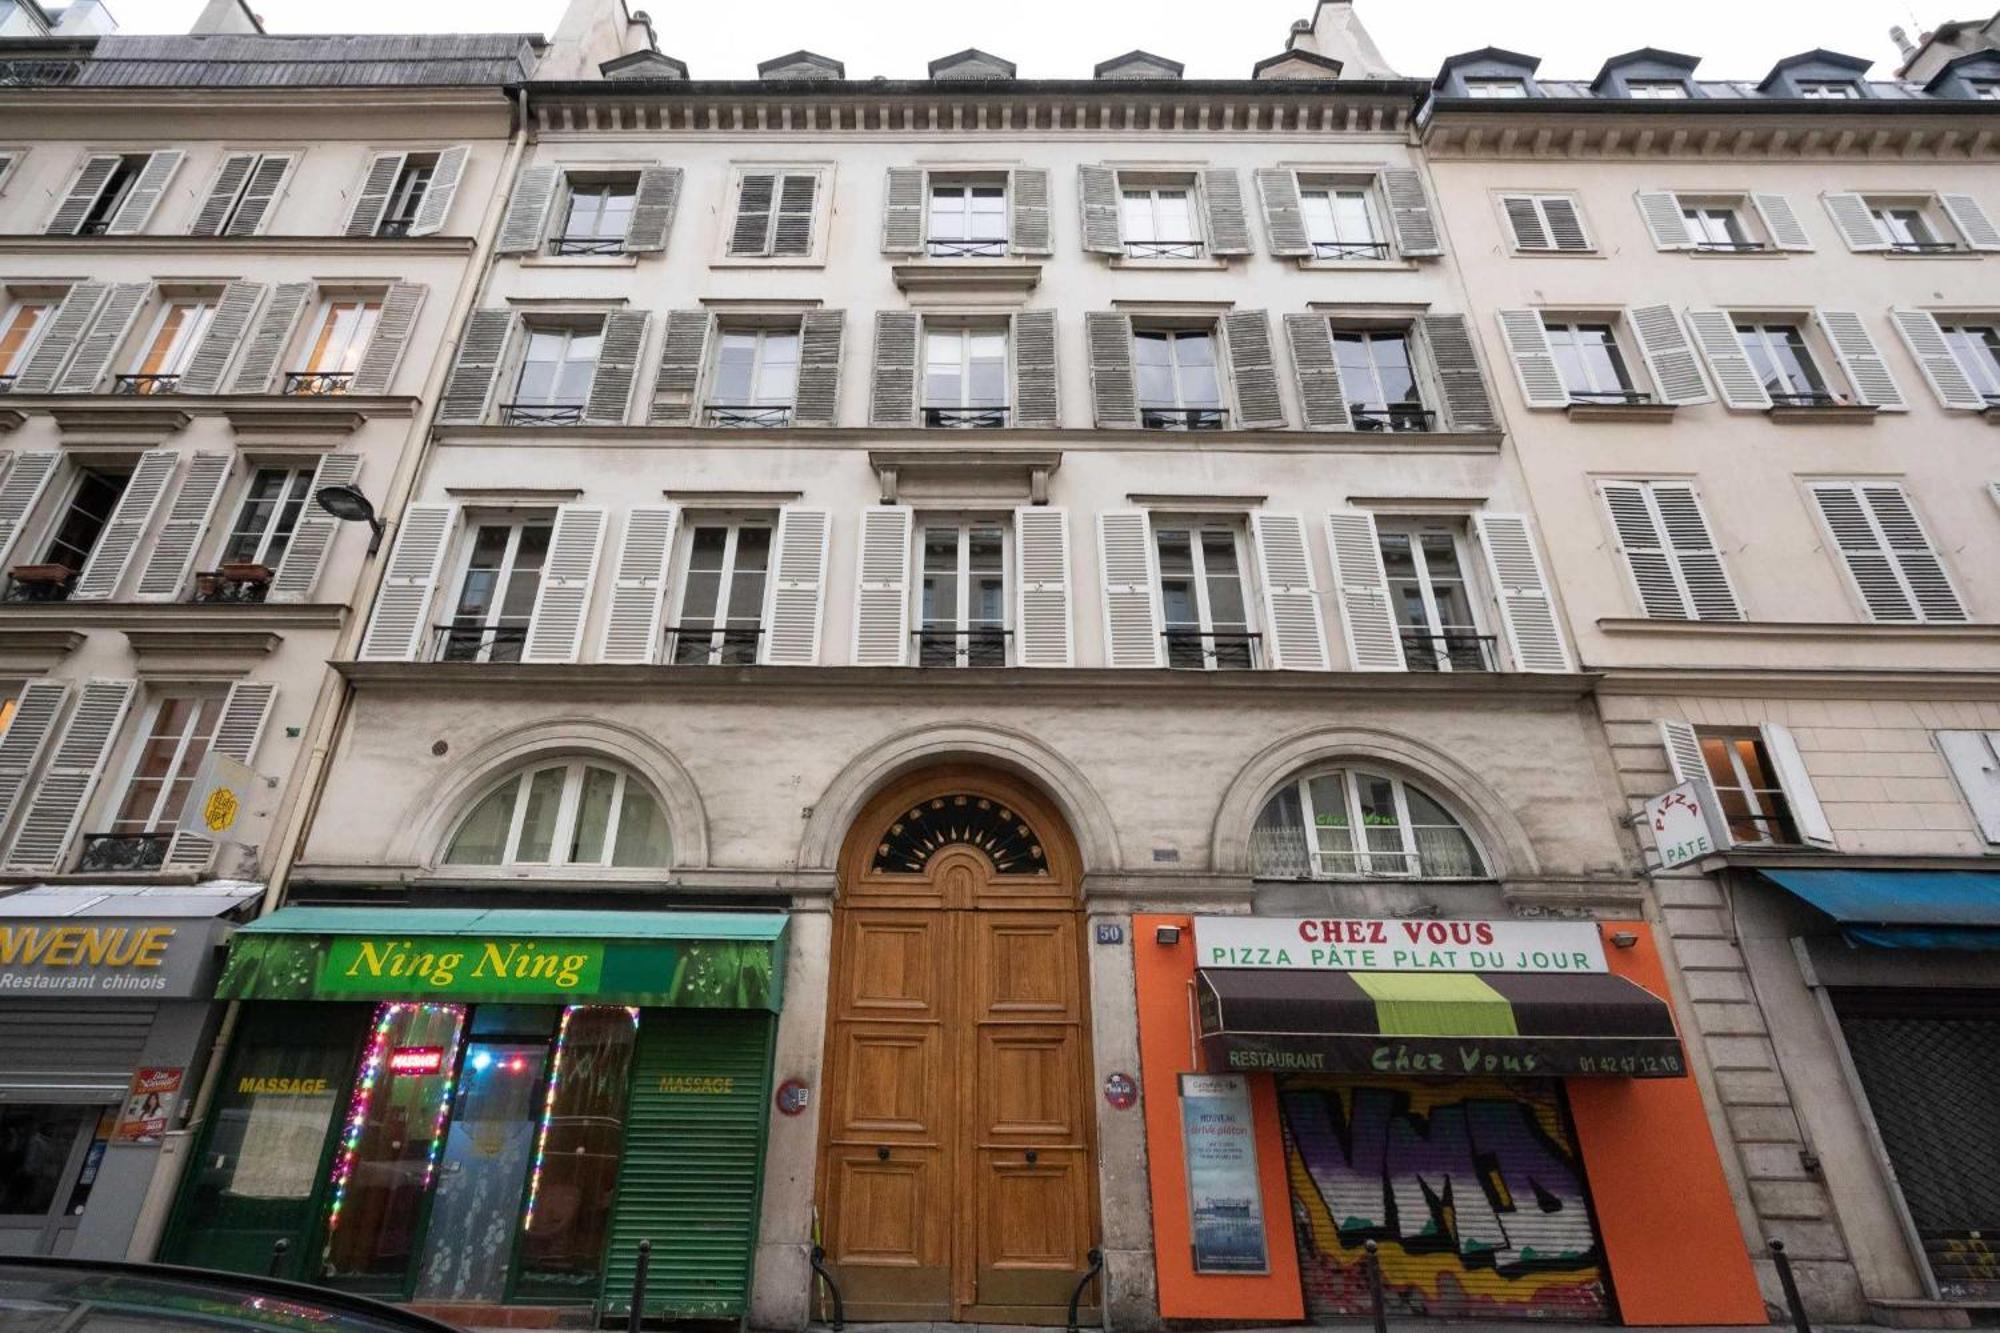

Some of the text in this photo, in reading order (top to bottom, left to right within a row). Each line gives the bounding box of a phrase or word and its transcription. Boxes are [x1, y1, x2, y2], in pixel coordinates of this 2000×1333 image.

[1655, 793, 1698, 832] PIZZA
[1100, 926, 1120, 941] 50
[1299, 920, 1494, 945] CHEZ VOUS
[346, 941, 589, 988] Ning Ning
[1212, 943, 1591, 969] PIZZA PÂTE PLAT DU JOUR
[0, 973, 166, 990] Restaurant chinois
[1229, 1051, 1325, 1069] RESTAURANT
[1371, 1045, 1537, 1072] Chez Vous
[1580, 1056, 1596, 1073] 01
[1600, 1056, 1618, 1073] 42
[1620, 1057, 1635, 1073] 47
[1640, 1057, 1658, 1074] 12
[238, 1077, 327, 1095] MASSAGE
[659, 1077, 734, 1094] MASSAGE
